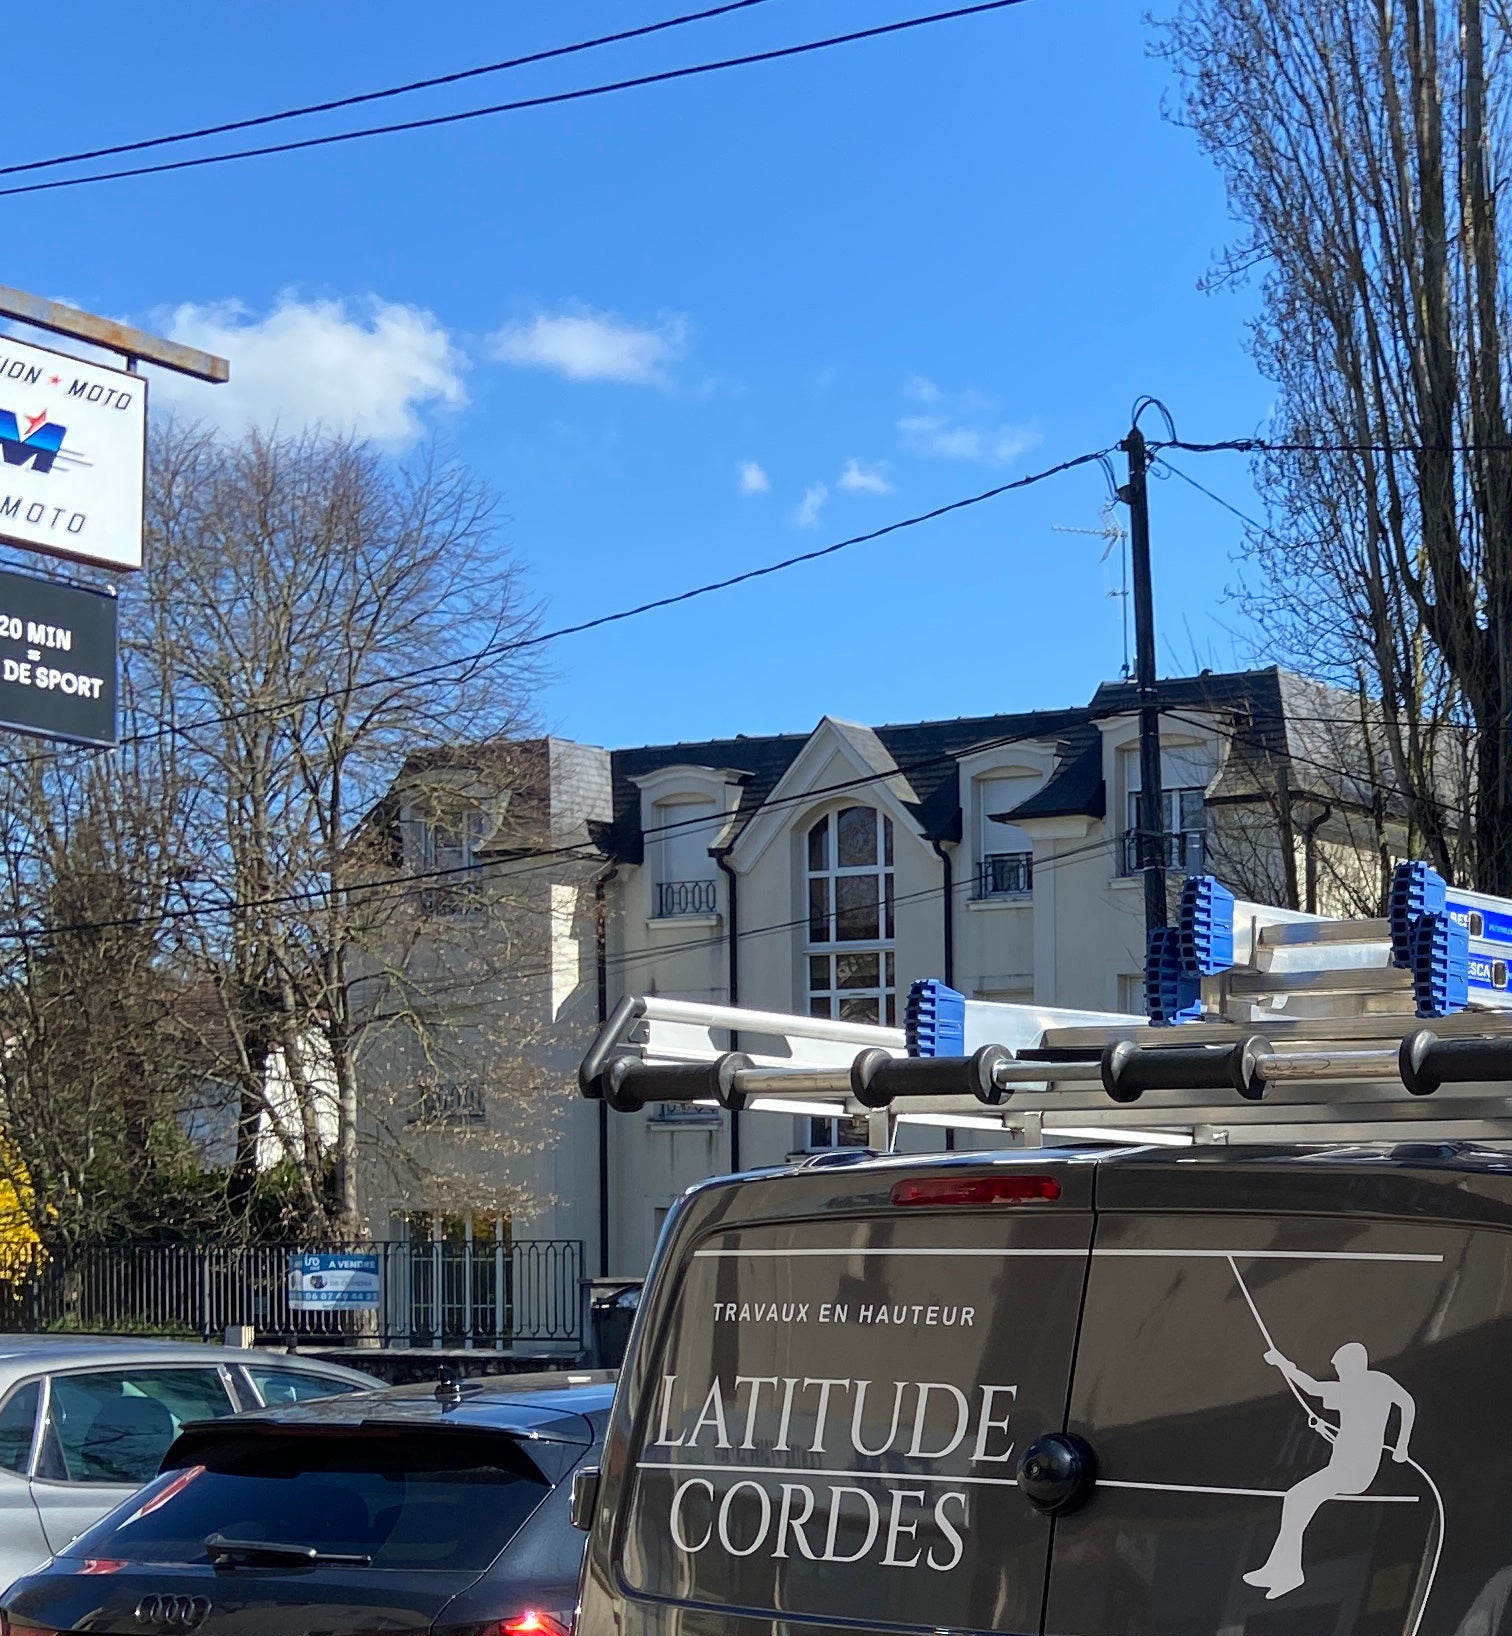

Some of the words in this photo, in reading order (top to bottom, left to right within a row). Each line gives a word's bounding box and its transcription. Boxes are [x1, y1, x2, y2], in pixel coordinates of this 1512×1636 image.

[68, 379, 132, 410] MOTO
[0, 495, 86, 533] MOTO
[27, 622, 71, 651] MIN
[3, 659, 31, 685] DE
[36, 667, 104, 699] SPORT
[338, 1261, 376, 1269] VENDRE
[713, 1303, 810, 1322] TRAVAUX
[819, 1303, 849, 1323] EN
[858, 1304, 976, 1326] HAUTEUR
[654, 1374, 1018, 1463] LATITUDE
[669, 1478, 967, 1571] CORDES
